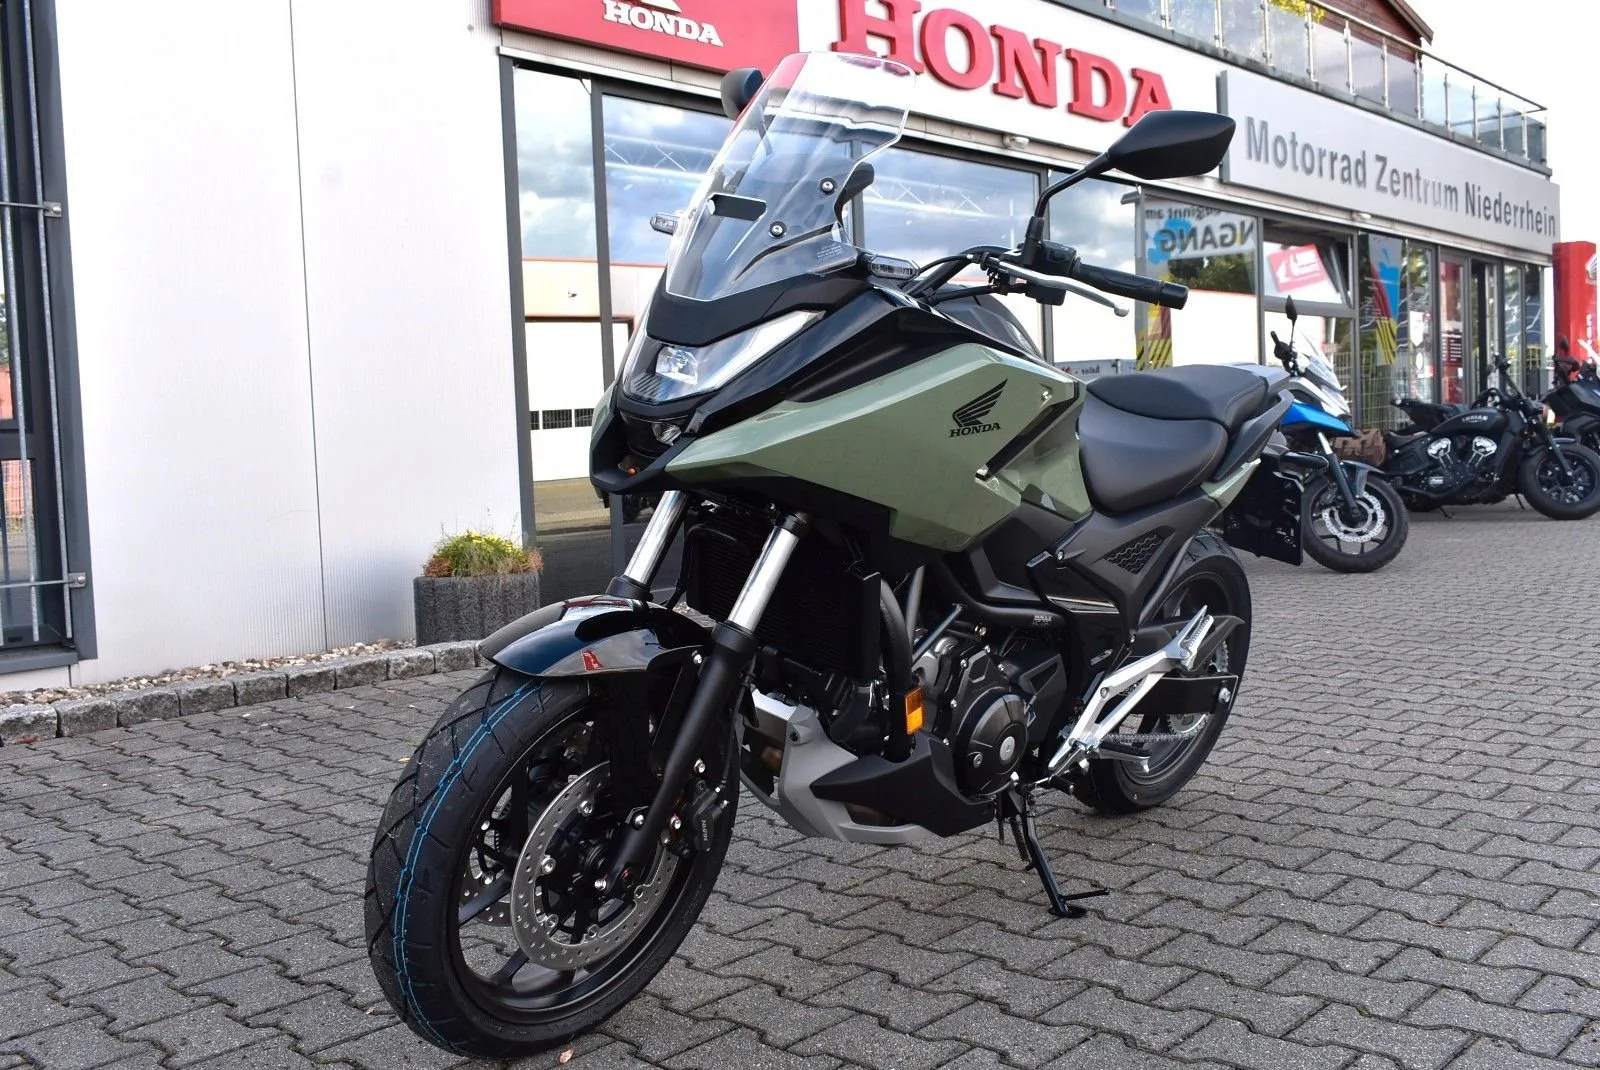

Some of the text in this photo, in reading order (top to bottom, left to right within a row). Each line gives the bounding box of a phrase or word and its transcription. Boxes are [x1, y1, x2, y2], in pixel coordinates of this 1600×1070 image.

[603, 0, 724, 47] HONDA
[832, 0, 1174, 127] HONDA
[1246, 115, 1556, 237] Motorrad Zentrum Niederrhein
[949, 422, 1001, 438] HONDA
